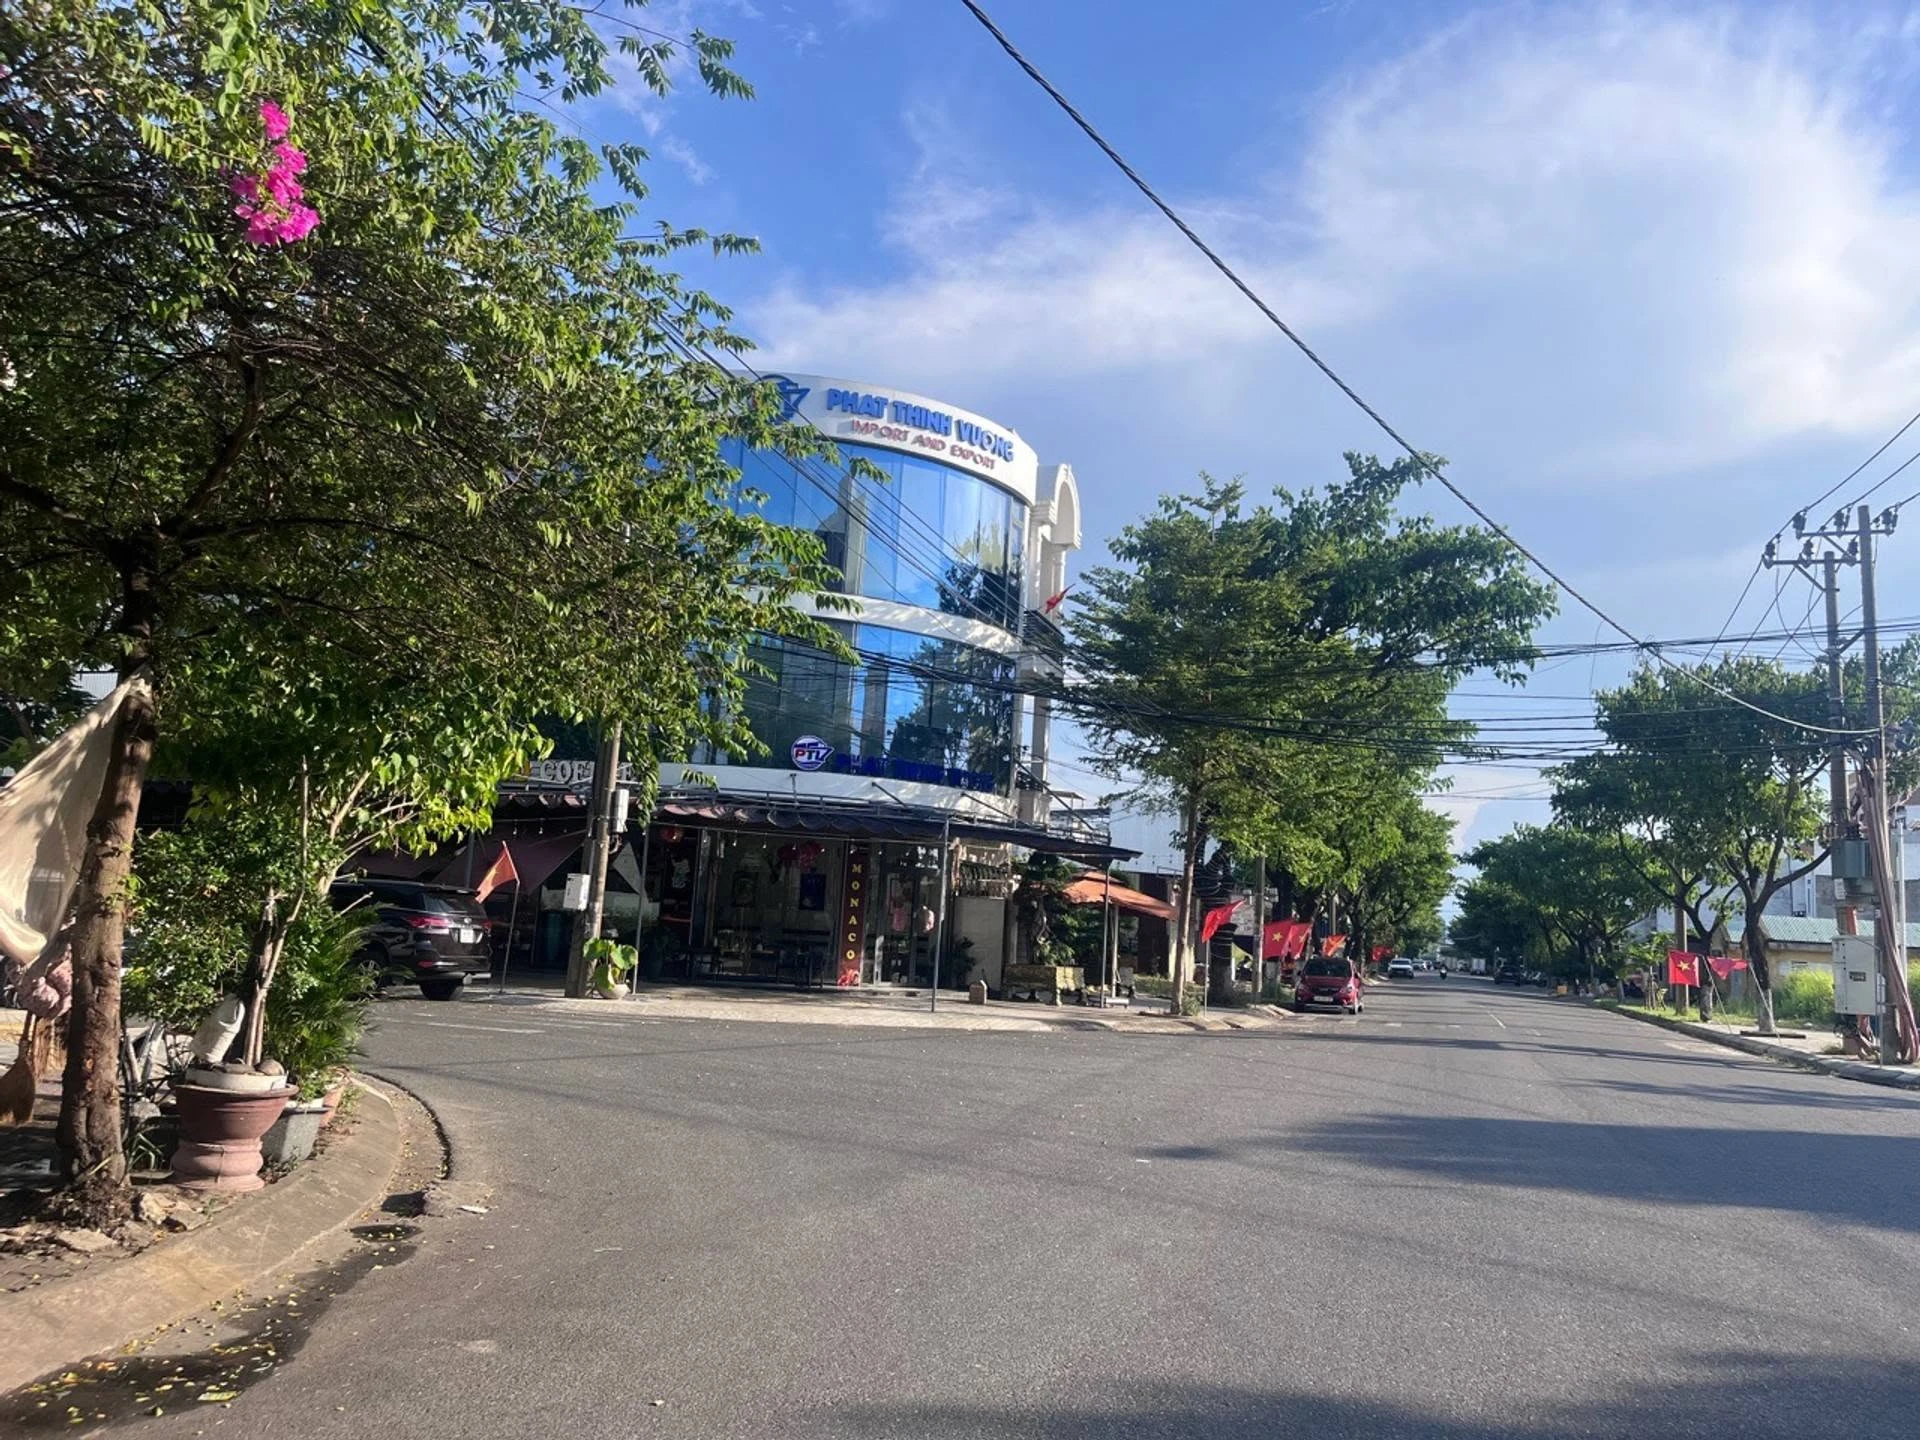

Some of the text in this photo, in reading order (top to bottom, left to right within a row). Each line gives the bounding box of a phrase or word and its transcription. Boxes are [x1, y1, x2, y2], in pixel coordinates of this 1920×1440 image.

[826, 388, 889, 419] PHAT
[893, 400, 953, 437] THINH
[851, 418, 996, 471] IMPORT AND EXPORT
[845, 863, 863, 960] MONACO
